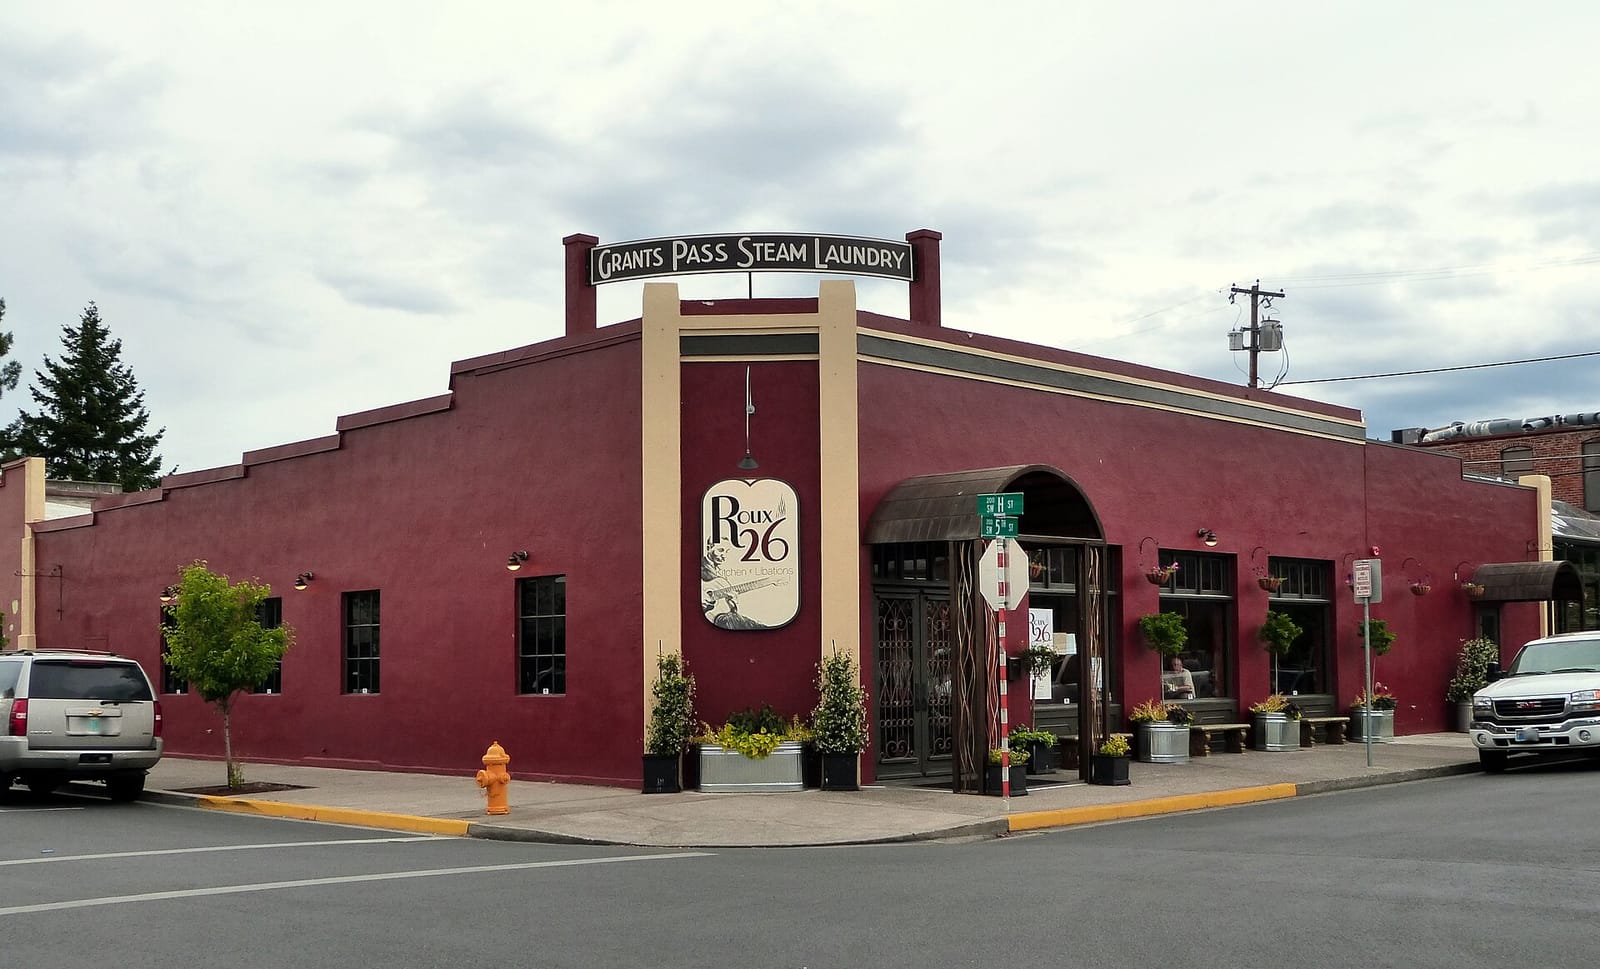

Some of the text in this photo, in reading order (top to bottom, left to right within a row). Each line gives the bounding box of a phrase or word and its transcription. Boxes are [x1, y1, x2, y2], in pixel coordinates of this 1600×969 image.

[598, 237, 905, 279] GRANTS PASS STEAM LAUNDRY
[998, 496, 1004, 513] H
[739, 517, 789, 562] 26
[755, 567, 794, 577] Libations
